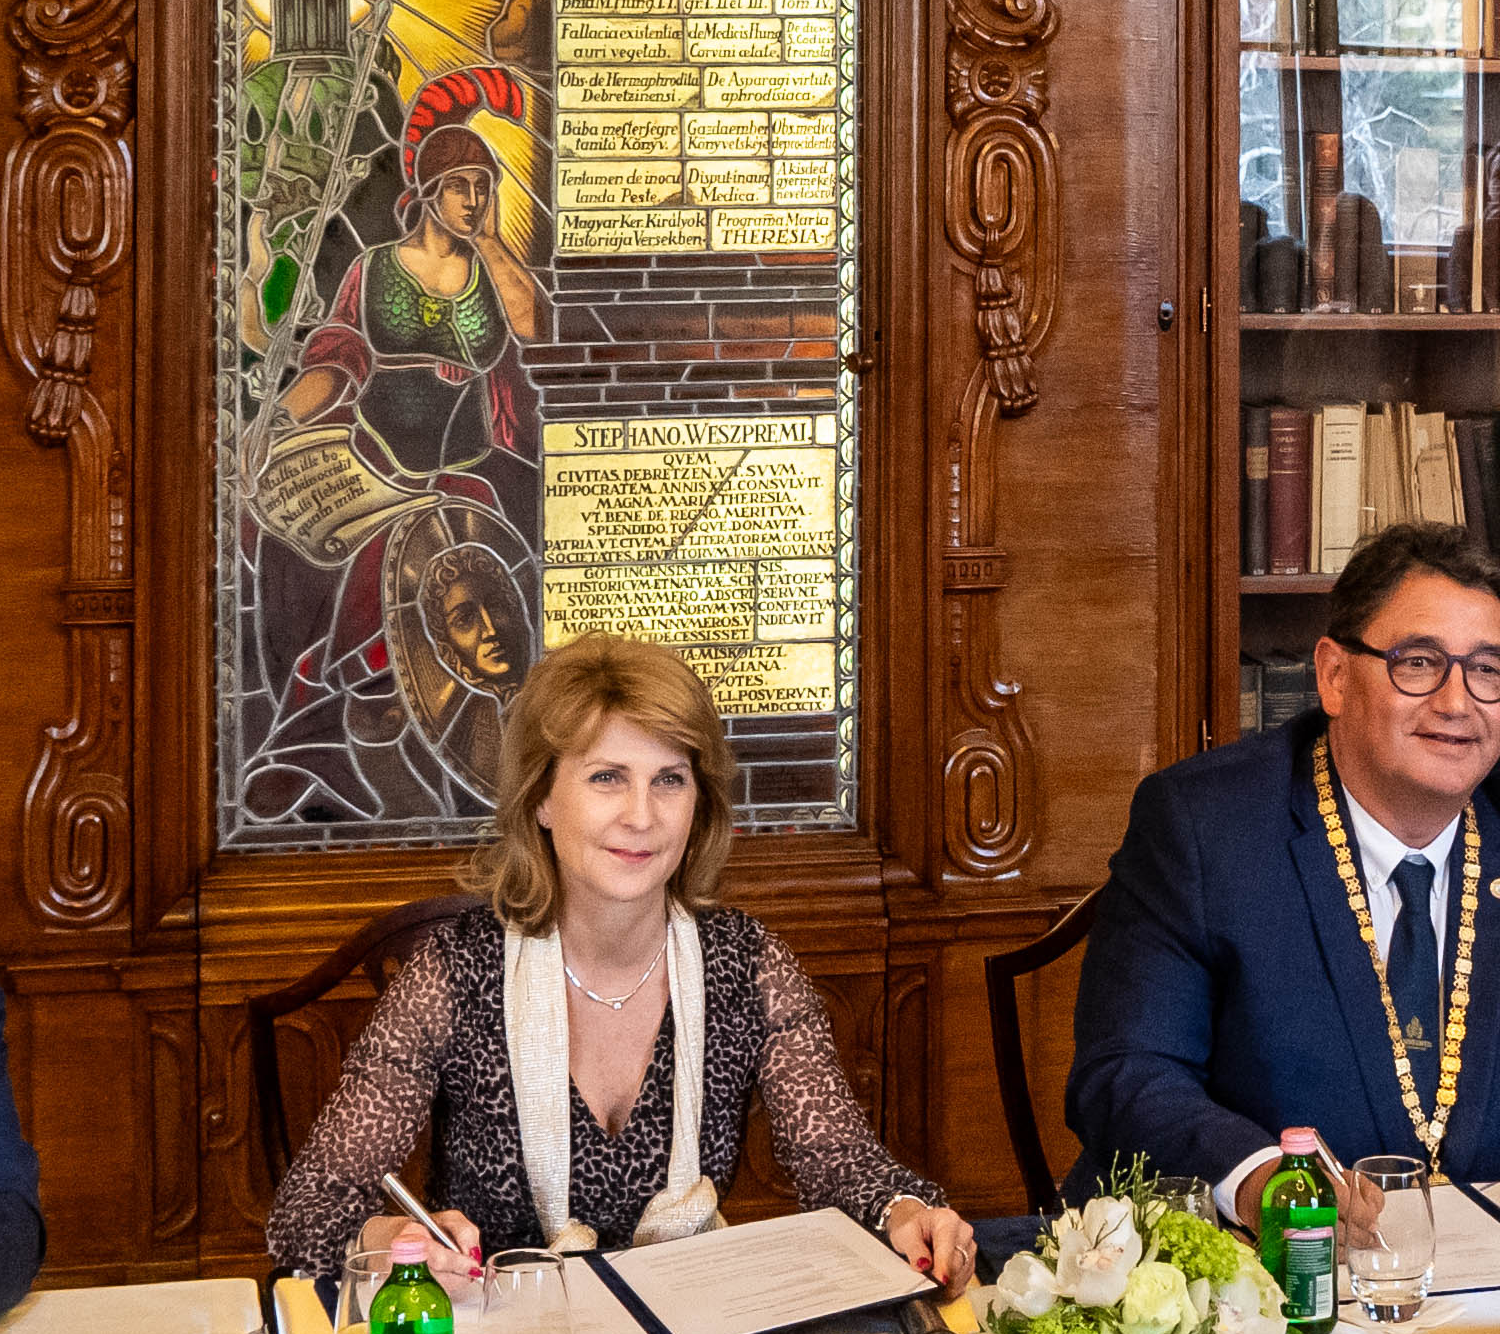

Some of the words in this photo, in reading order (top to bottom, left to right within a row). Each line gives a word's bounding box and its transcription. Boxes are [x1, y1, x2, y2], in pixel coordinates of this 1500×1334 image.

[561, 23, 618, 39] Fallacia
[573, 44, 606, 58] auri
[611, 44, 671, 62] vegetab.
[690, 42, 736, 58] Corvini
[589, 73, 605, 87] de
[707, 72, 725, 87] De
[728, 72, 789, 90] Asparagi
[560, 169, 624, 186] Tentamen
[626, 169, 642, 185] de
[575, 189, 615, 203] landa
[562, 215, 619, 232] Magyar
[645, 211, 706, 230] Királyok
[784, 212, 829, 226] Maria
[572, 607, 624, 620] CORPVS
